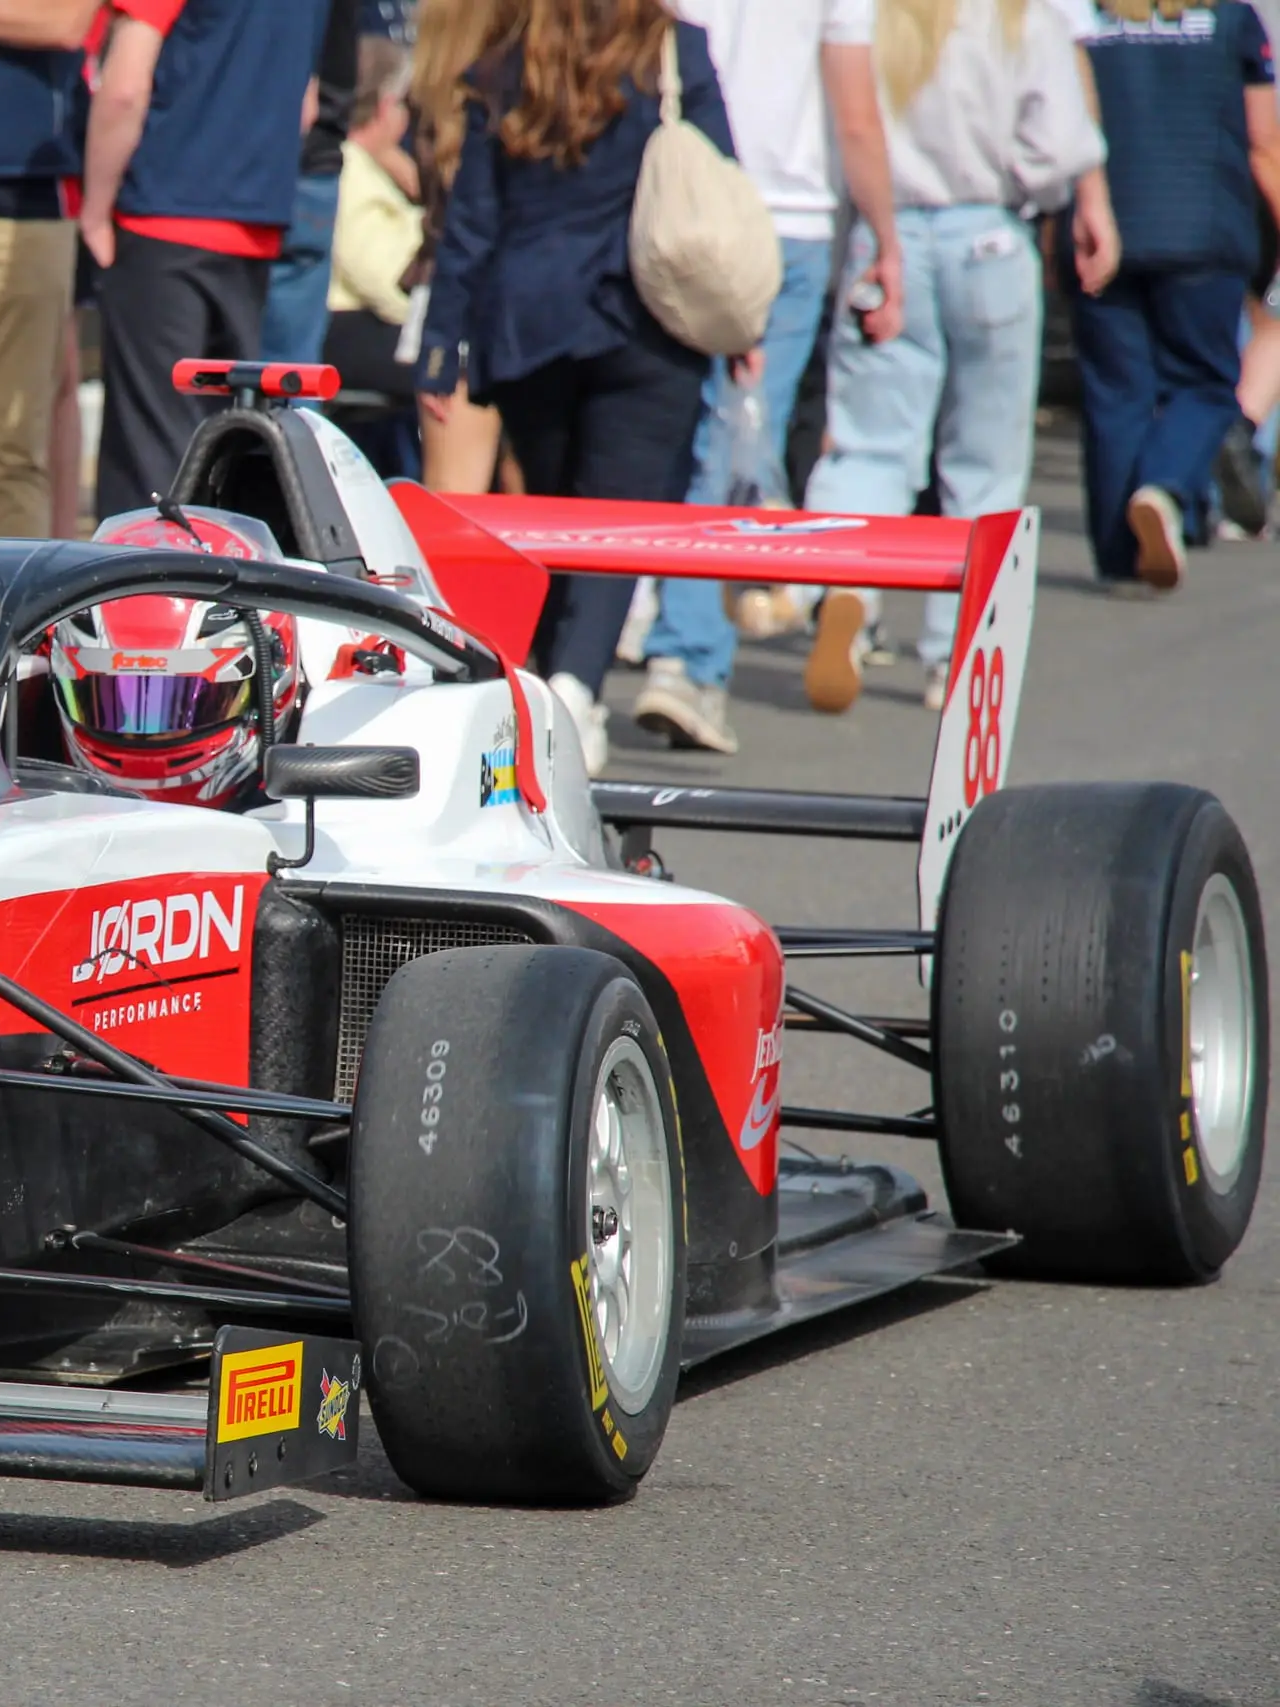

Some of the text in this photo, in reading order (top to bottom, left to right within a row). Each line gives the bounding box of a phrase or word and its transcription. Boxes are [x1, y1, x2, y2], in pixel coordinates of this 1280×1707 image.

[964, 645, 1005, 811] 88
[93, 990, 203, 1032] PERFORMANCE
[418, 1039, 451, 1156] 46309
[226, 1359, 296, 1426] PIRELLI
